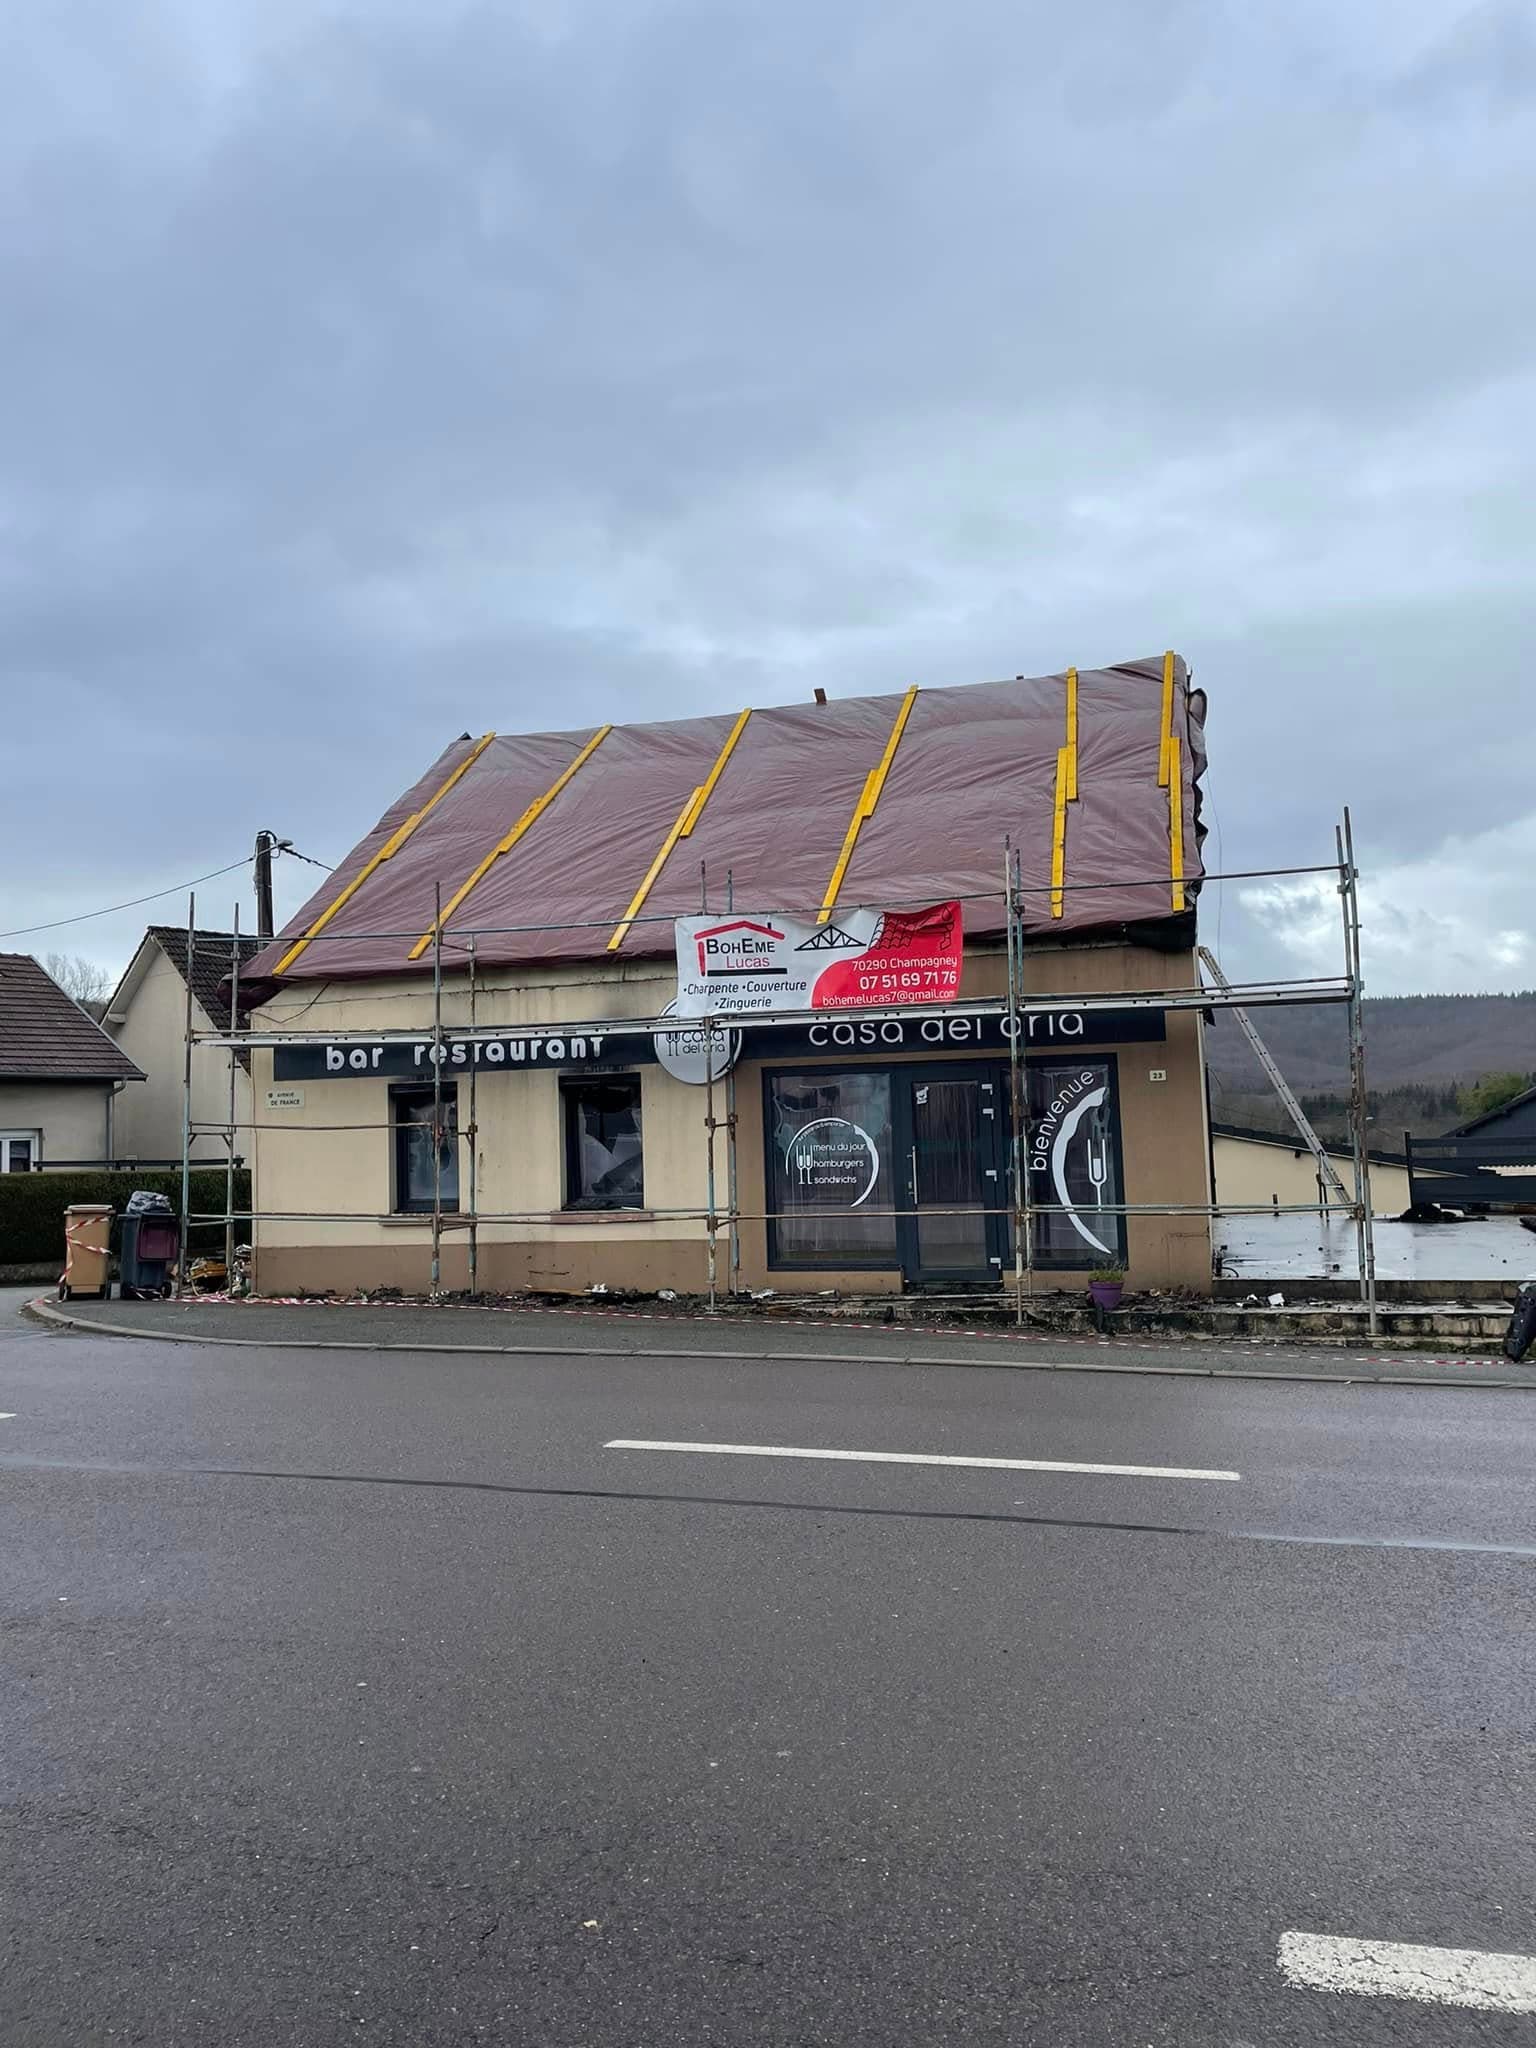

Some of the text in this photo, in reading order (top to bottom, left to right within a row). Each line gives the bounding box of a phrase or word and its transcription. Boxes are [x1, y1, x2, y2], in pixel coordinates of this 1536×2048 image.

[726, 956, 771, 969] Lucas
[852, 956, 957, 971] 70290 Champagney
[860, 970, 957, 990] 07 51 69 71 76
[822, 989, 955, 1006] bohemelucas7@gmail.com
[808, 1021, 904, 1045] casa
[326, 1037, 603, 1070] bar restaurant
[683, 1043, 700, 1054] del
[280, 1098, 300, 1106] FRANCE
[1029, 1071, 1094, 1171] bienvenue
[814, 1143, 866, 1153] menu du jour
[813, 1159, 864, 1169] hamburgers
[814, 1175, 857, 1184] sandwichs
